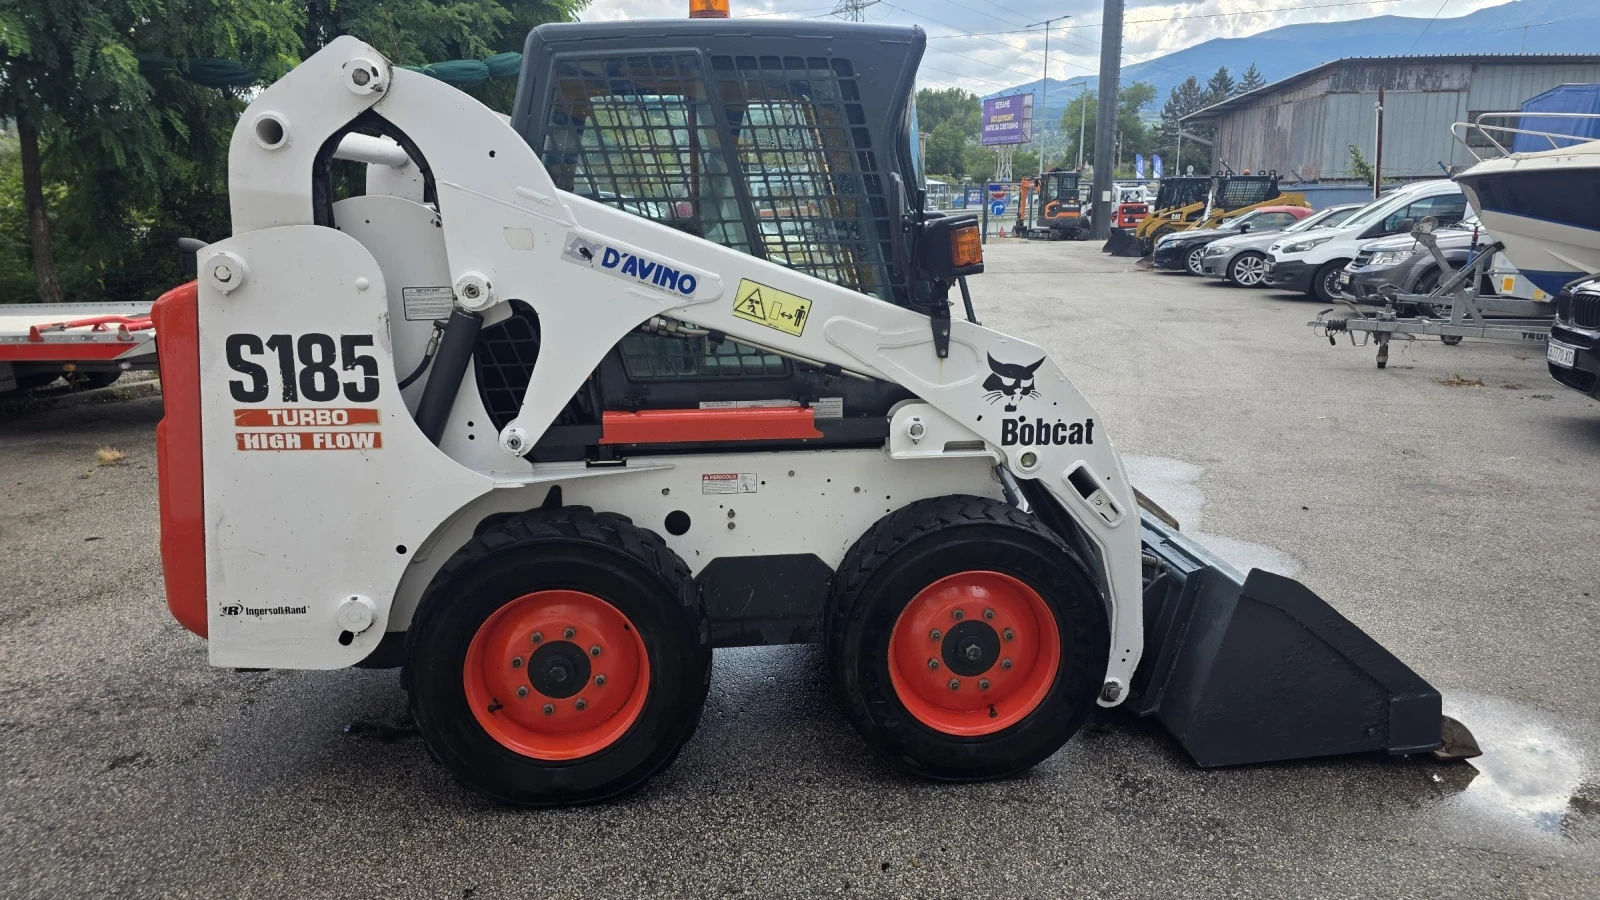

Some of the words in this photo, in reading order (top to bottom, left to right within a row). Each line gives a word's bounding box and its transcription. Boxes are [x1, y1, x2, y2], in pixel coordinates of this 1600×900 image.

[995, 100, 1010, 109] SESAME
[225, 333, 380, 403] S185
[267, 409, 348, 426] TURBO
[1001, 417, 1095, 446] Bobcat
[243, 433, 301, 449] HIGH
[312, 432, 375, 449] FLOW
